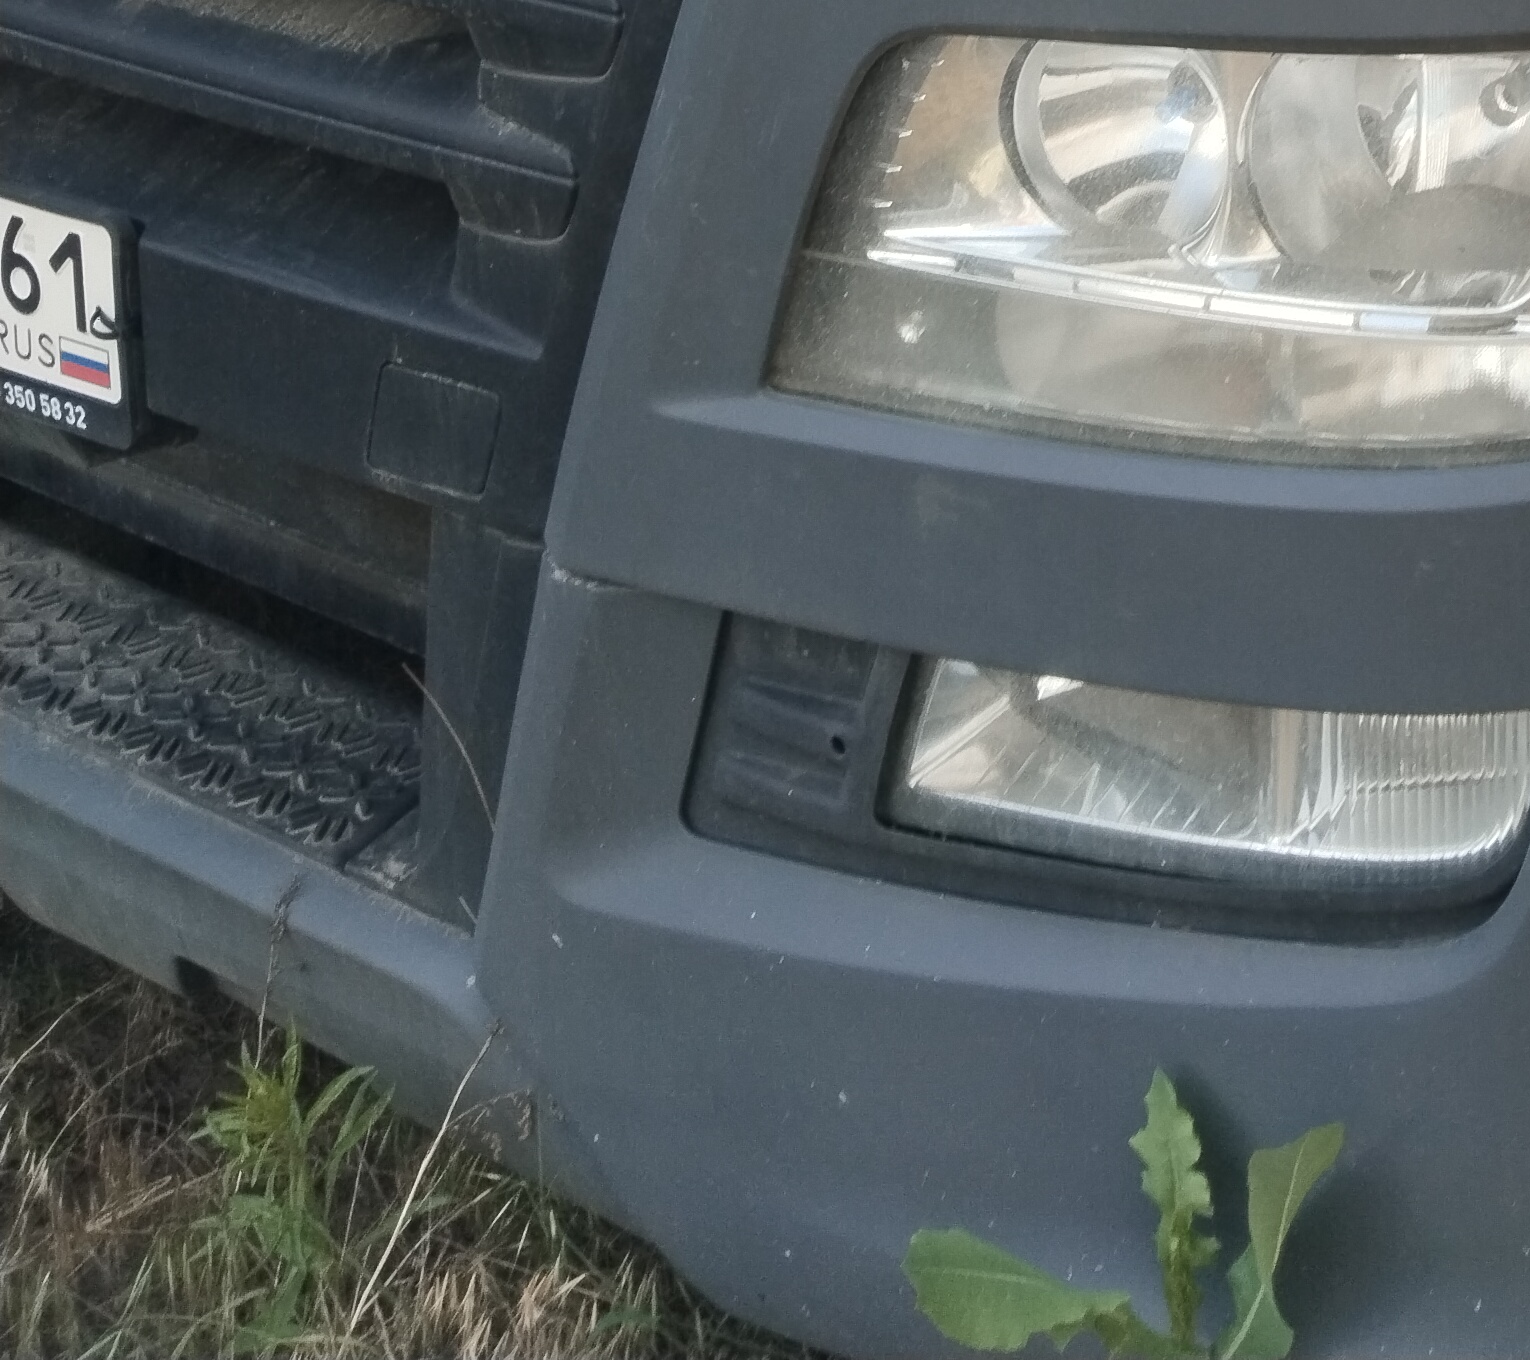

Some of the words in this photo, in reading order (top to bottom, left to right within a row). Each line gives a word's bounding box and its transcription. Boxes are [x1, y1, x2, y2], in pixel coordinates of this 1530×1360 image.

[1, 215, 87, 333] 61
[3, 381, 36, 412] 350
[40, 393, 62, 421] 58
[64, 401, 87, 430] 32
